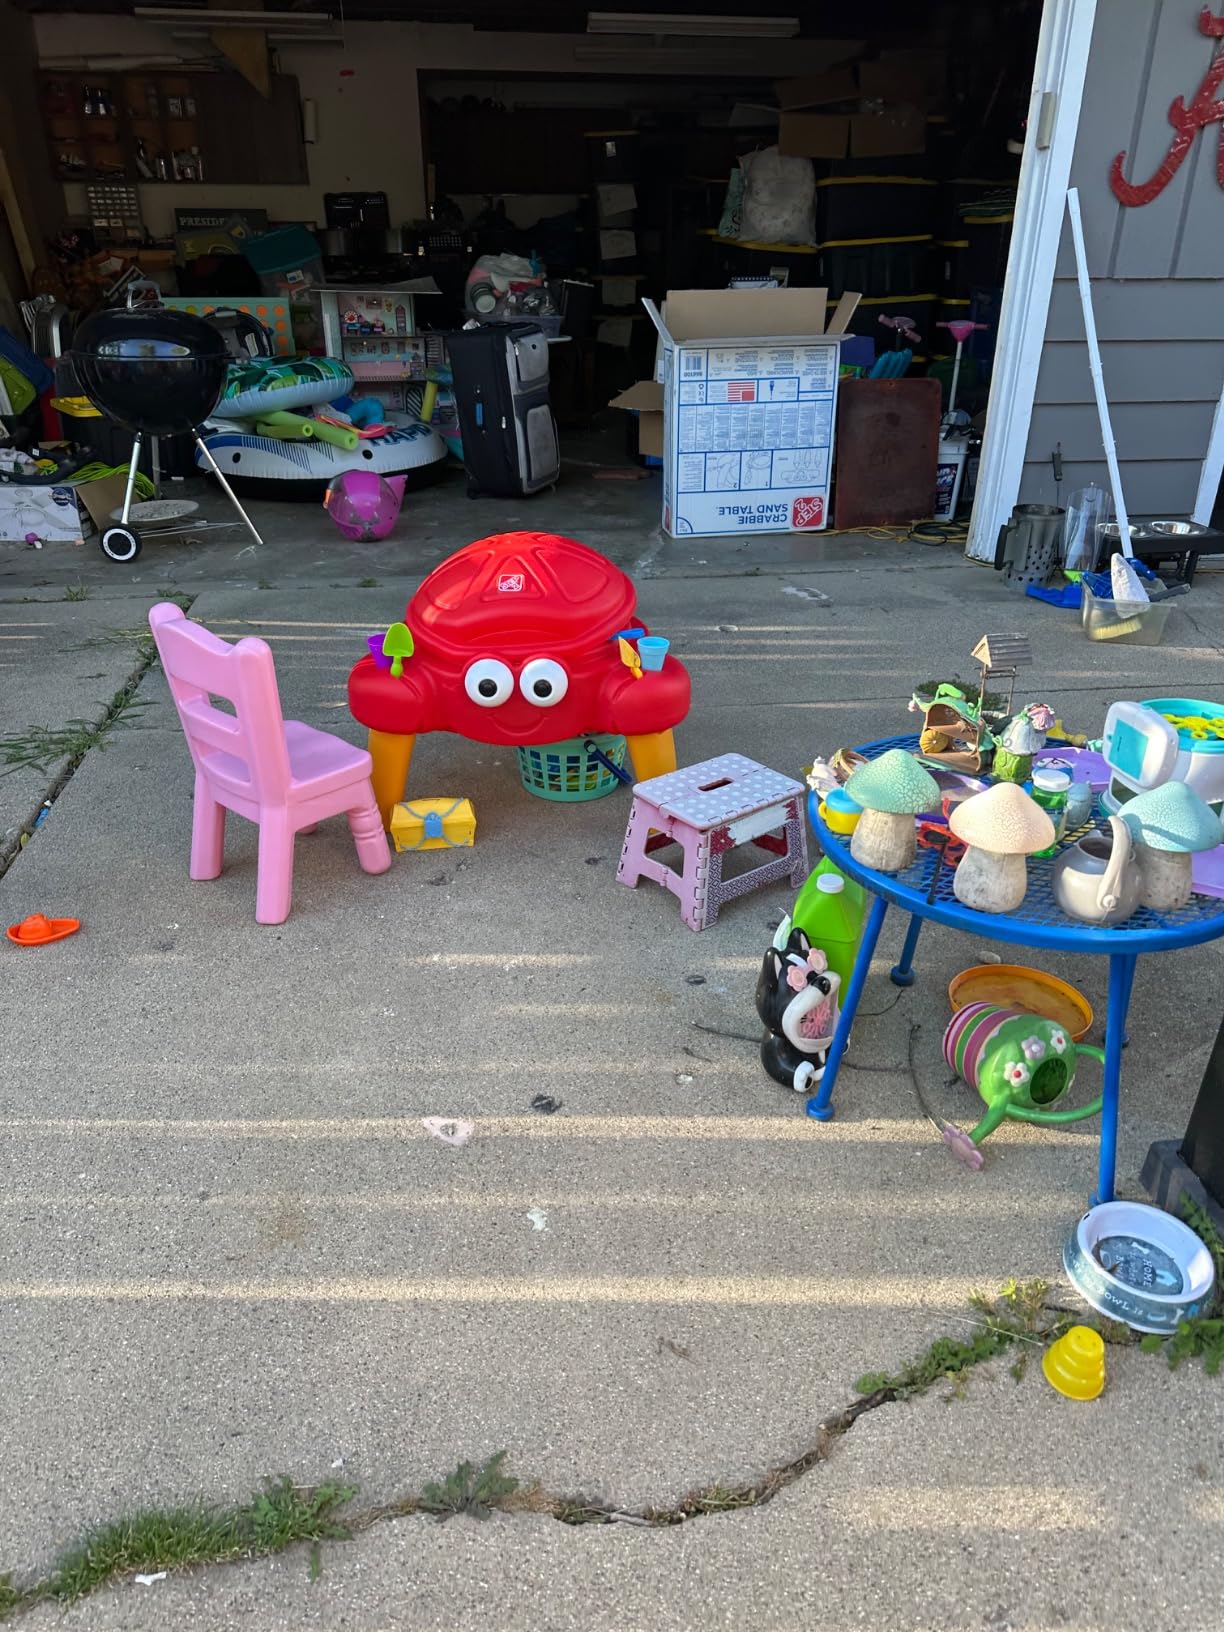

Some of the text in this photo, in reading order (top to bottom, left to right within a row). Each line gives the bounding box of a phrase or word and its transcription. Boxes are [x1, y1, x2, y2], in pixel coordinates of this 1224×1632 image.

[718, 503, 789, 515] SAND TABLE
[737, 513, 788, 525] CRABBIE
[795, 498, 823, 527] STEP
[1142, 1258, 1152, 1288] HOME
